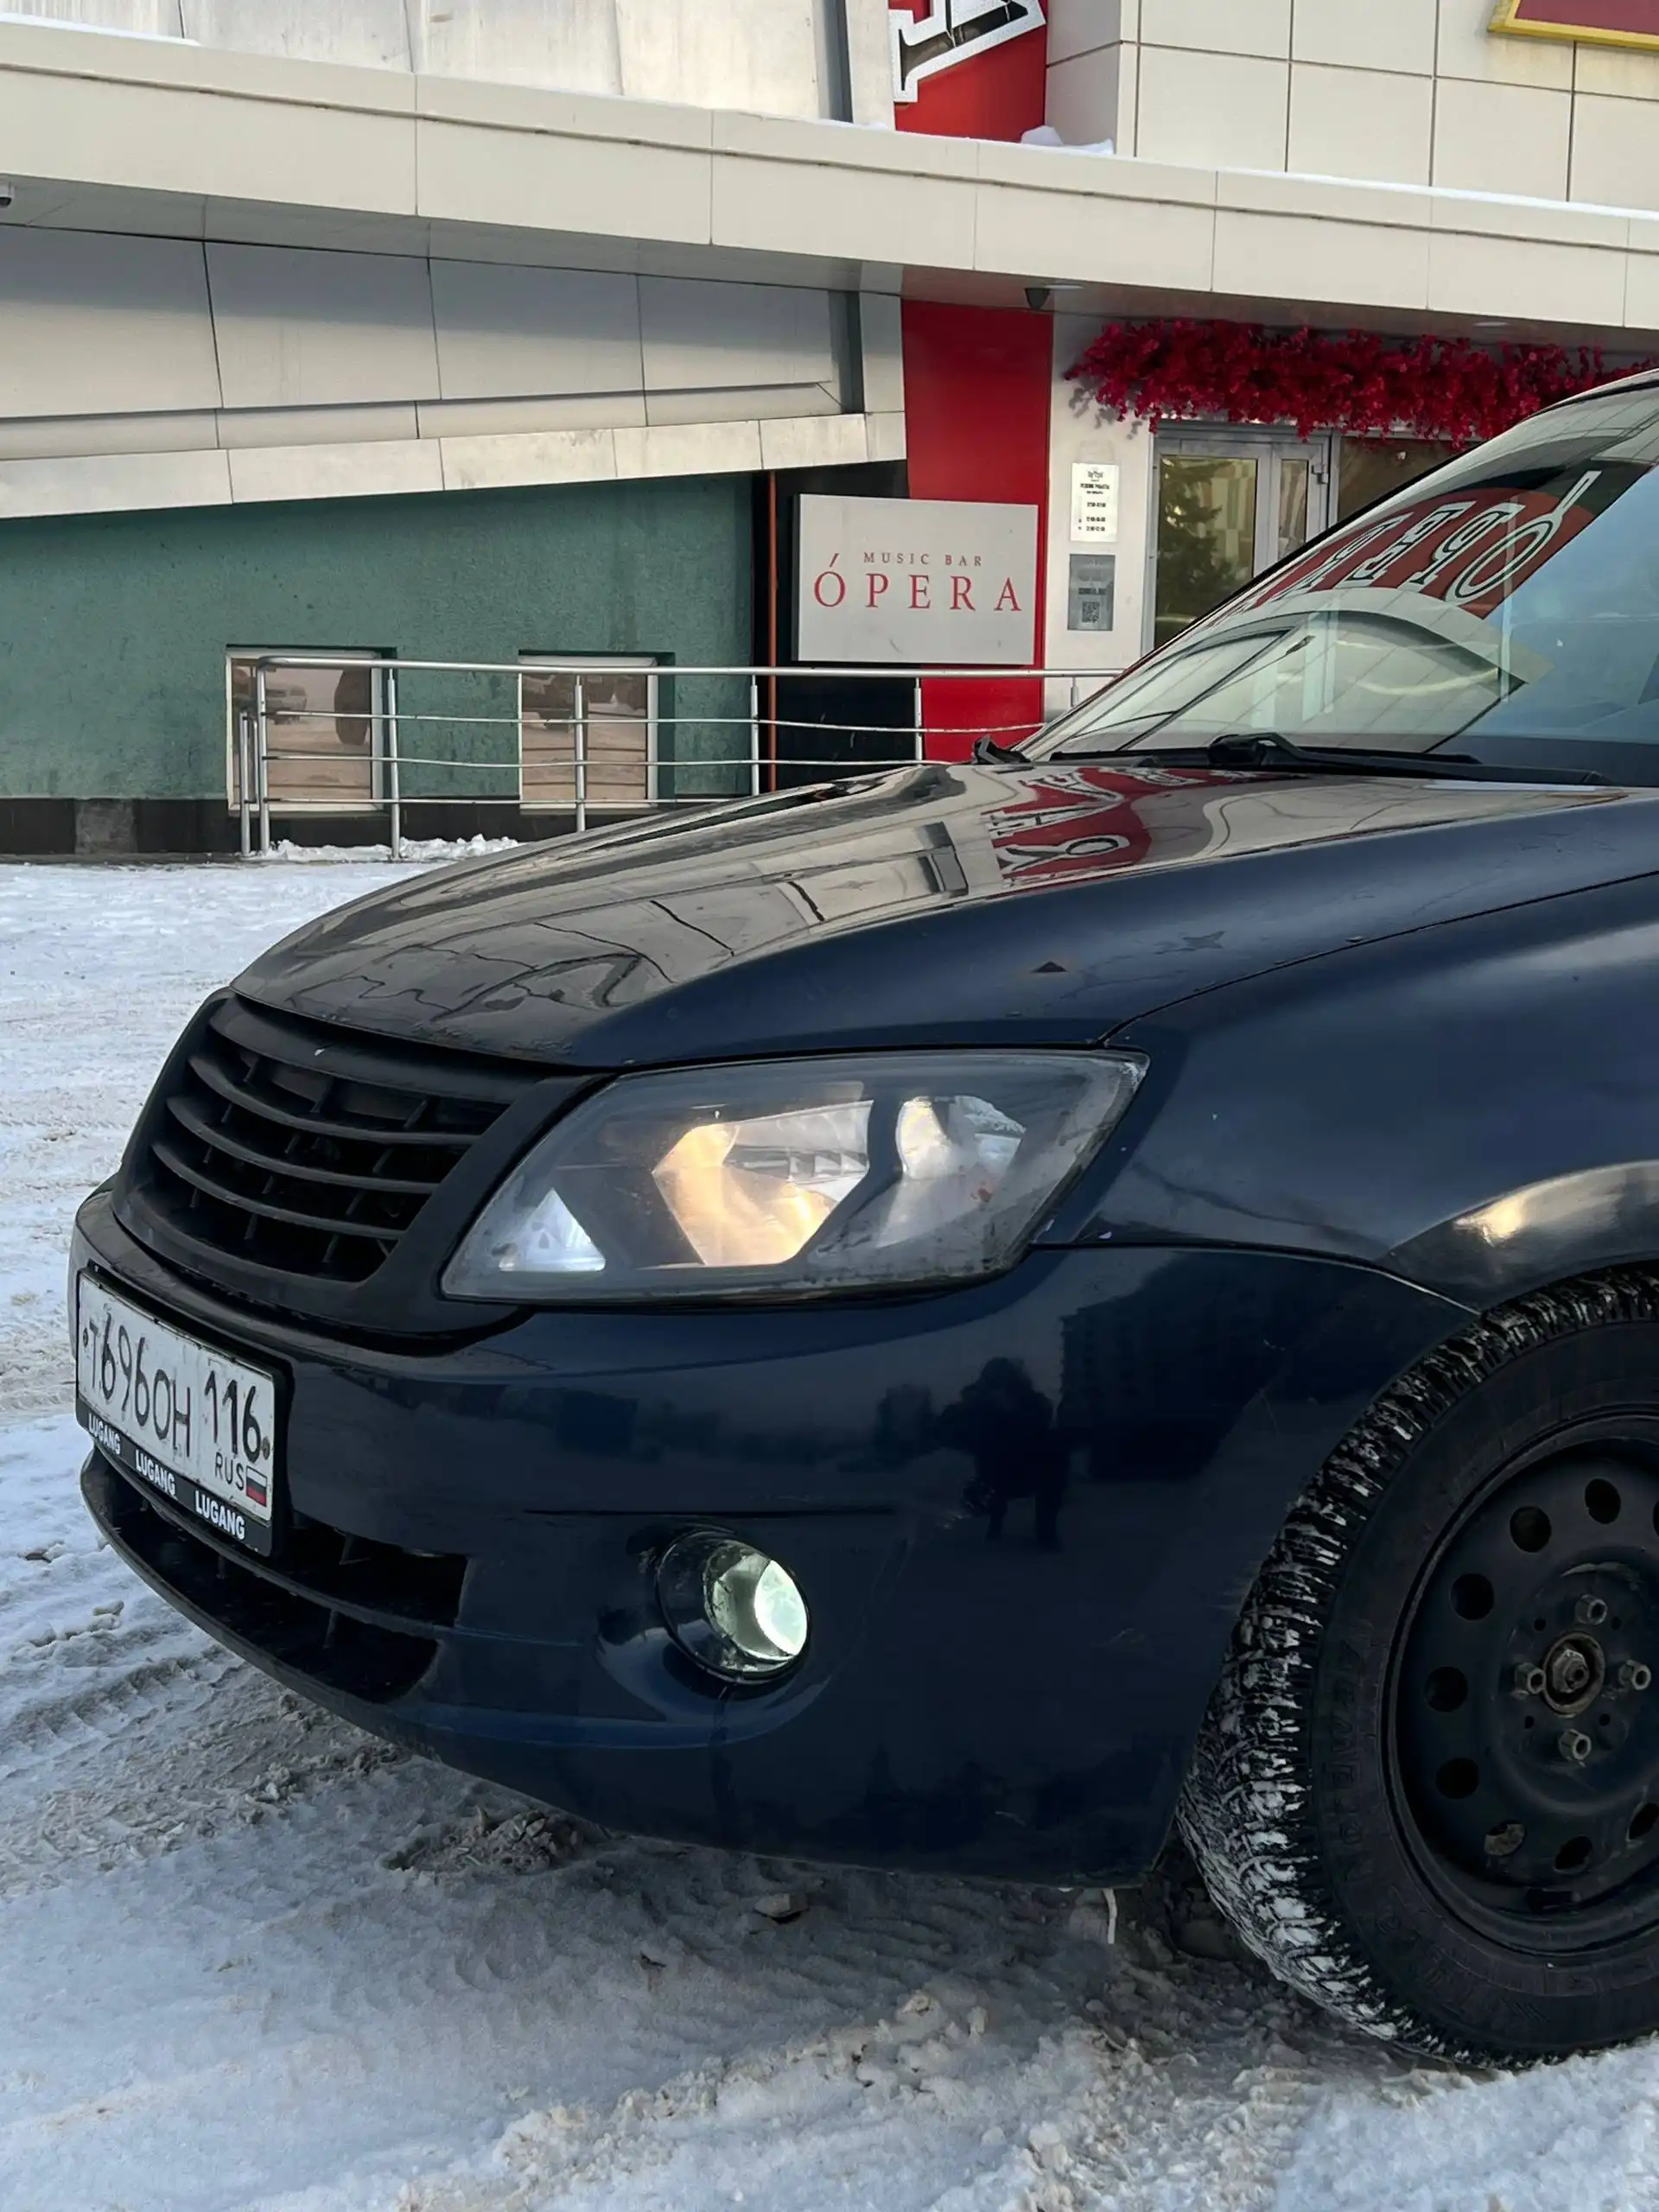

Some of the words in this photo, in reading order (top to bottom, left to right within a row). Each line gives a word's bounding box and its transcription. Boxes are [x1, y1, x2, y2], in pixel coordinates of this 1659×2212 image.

[814, 552, 1022, 612] ÓPERA
[864, 551, 930, 565] MUSIC
[944, 555, 982, 567] BAR
[204, 1370, 261, 1464] 116
[88, 1412, 122, 1455] LUGANG
[135, 1449, 176, 1497] LUGANG
[194, 1490, 245, 1541] LUGANG
[215, 1452, 245, 1491] RUS
